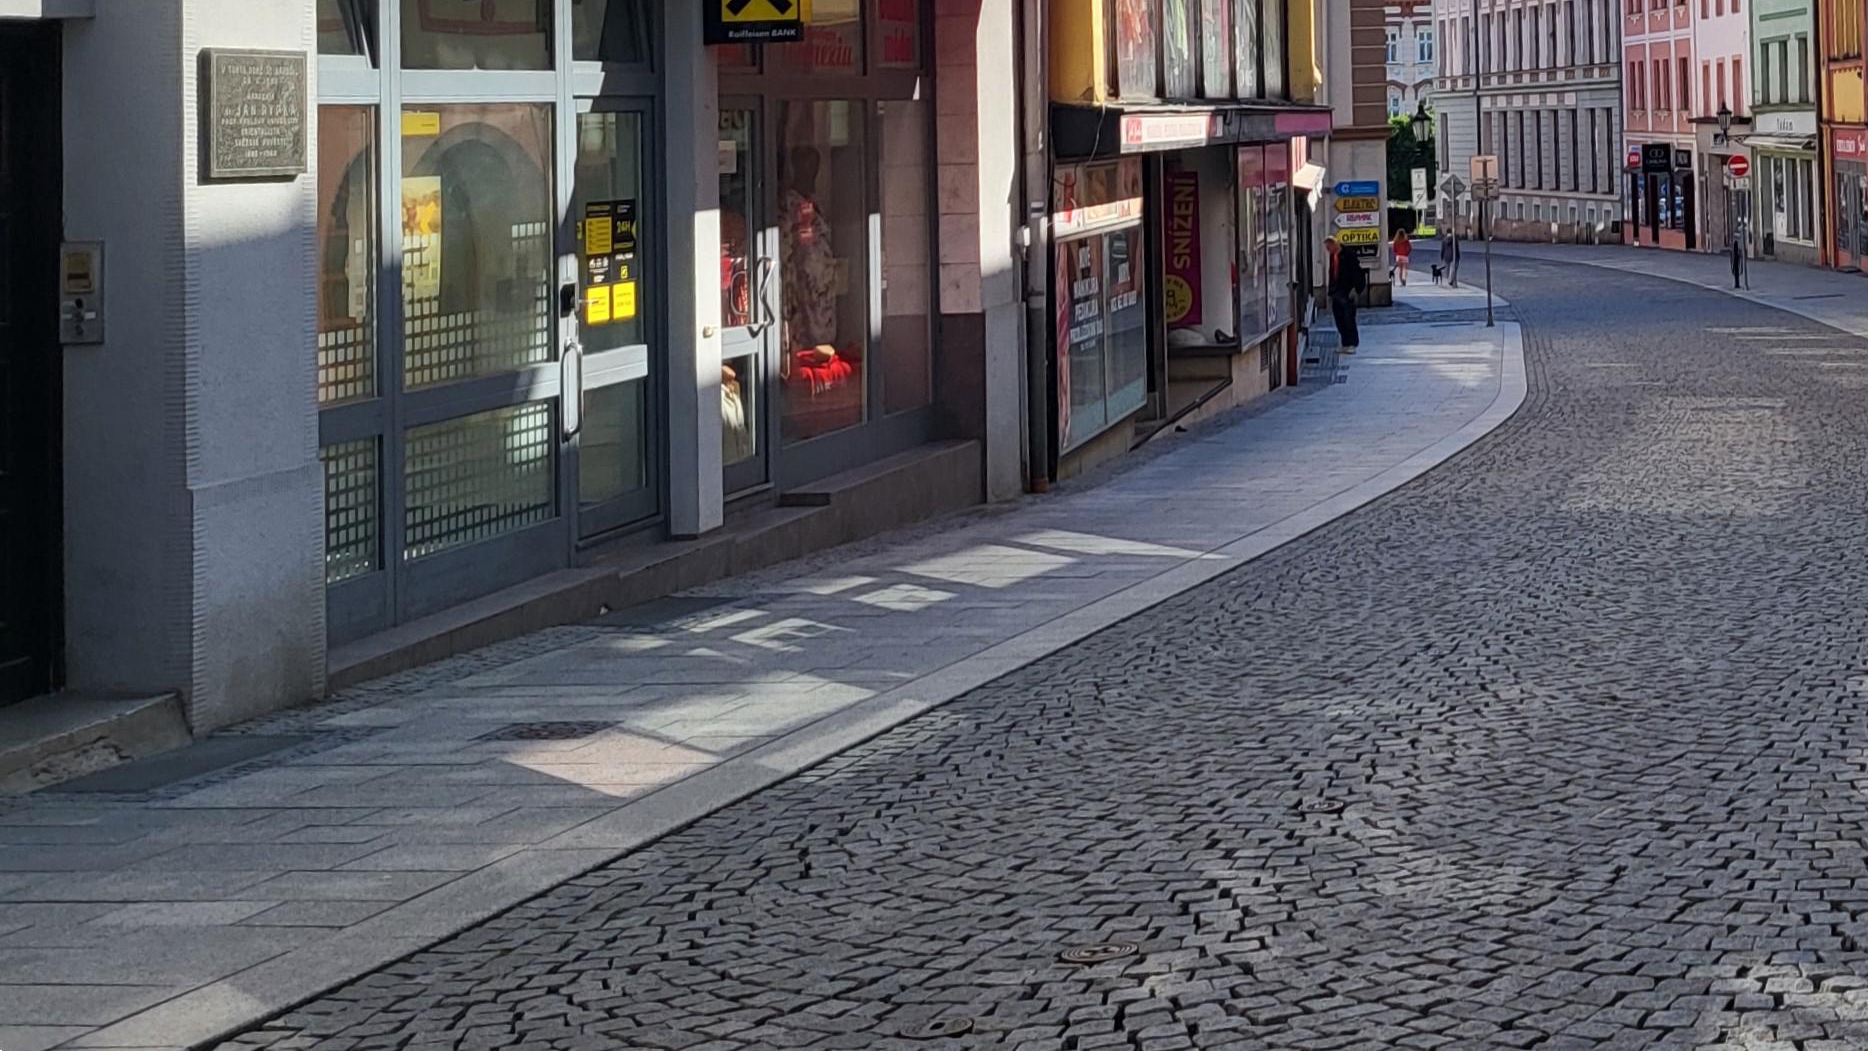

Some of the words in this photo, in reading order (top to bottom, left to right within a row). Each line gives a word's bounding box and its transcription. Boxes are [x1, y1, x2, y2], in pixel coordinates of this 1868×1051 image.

[728, 30, 770, 39] Raiffeisen
[771, 28, 797, 38] BANK
[1167, 178, 1195, 270] SNÍŽENÍ
[1341, 232, 1378, 243] OPTIKA
